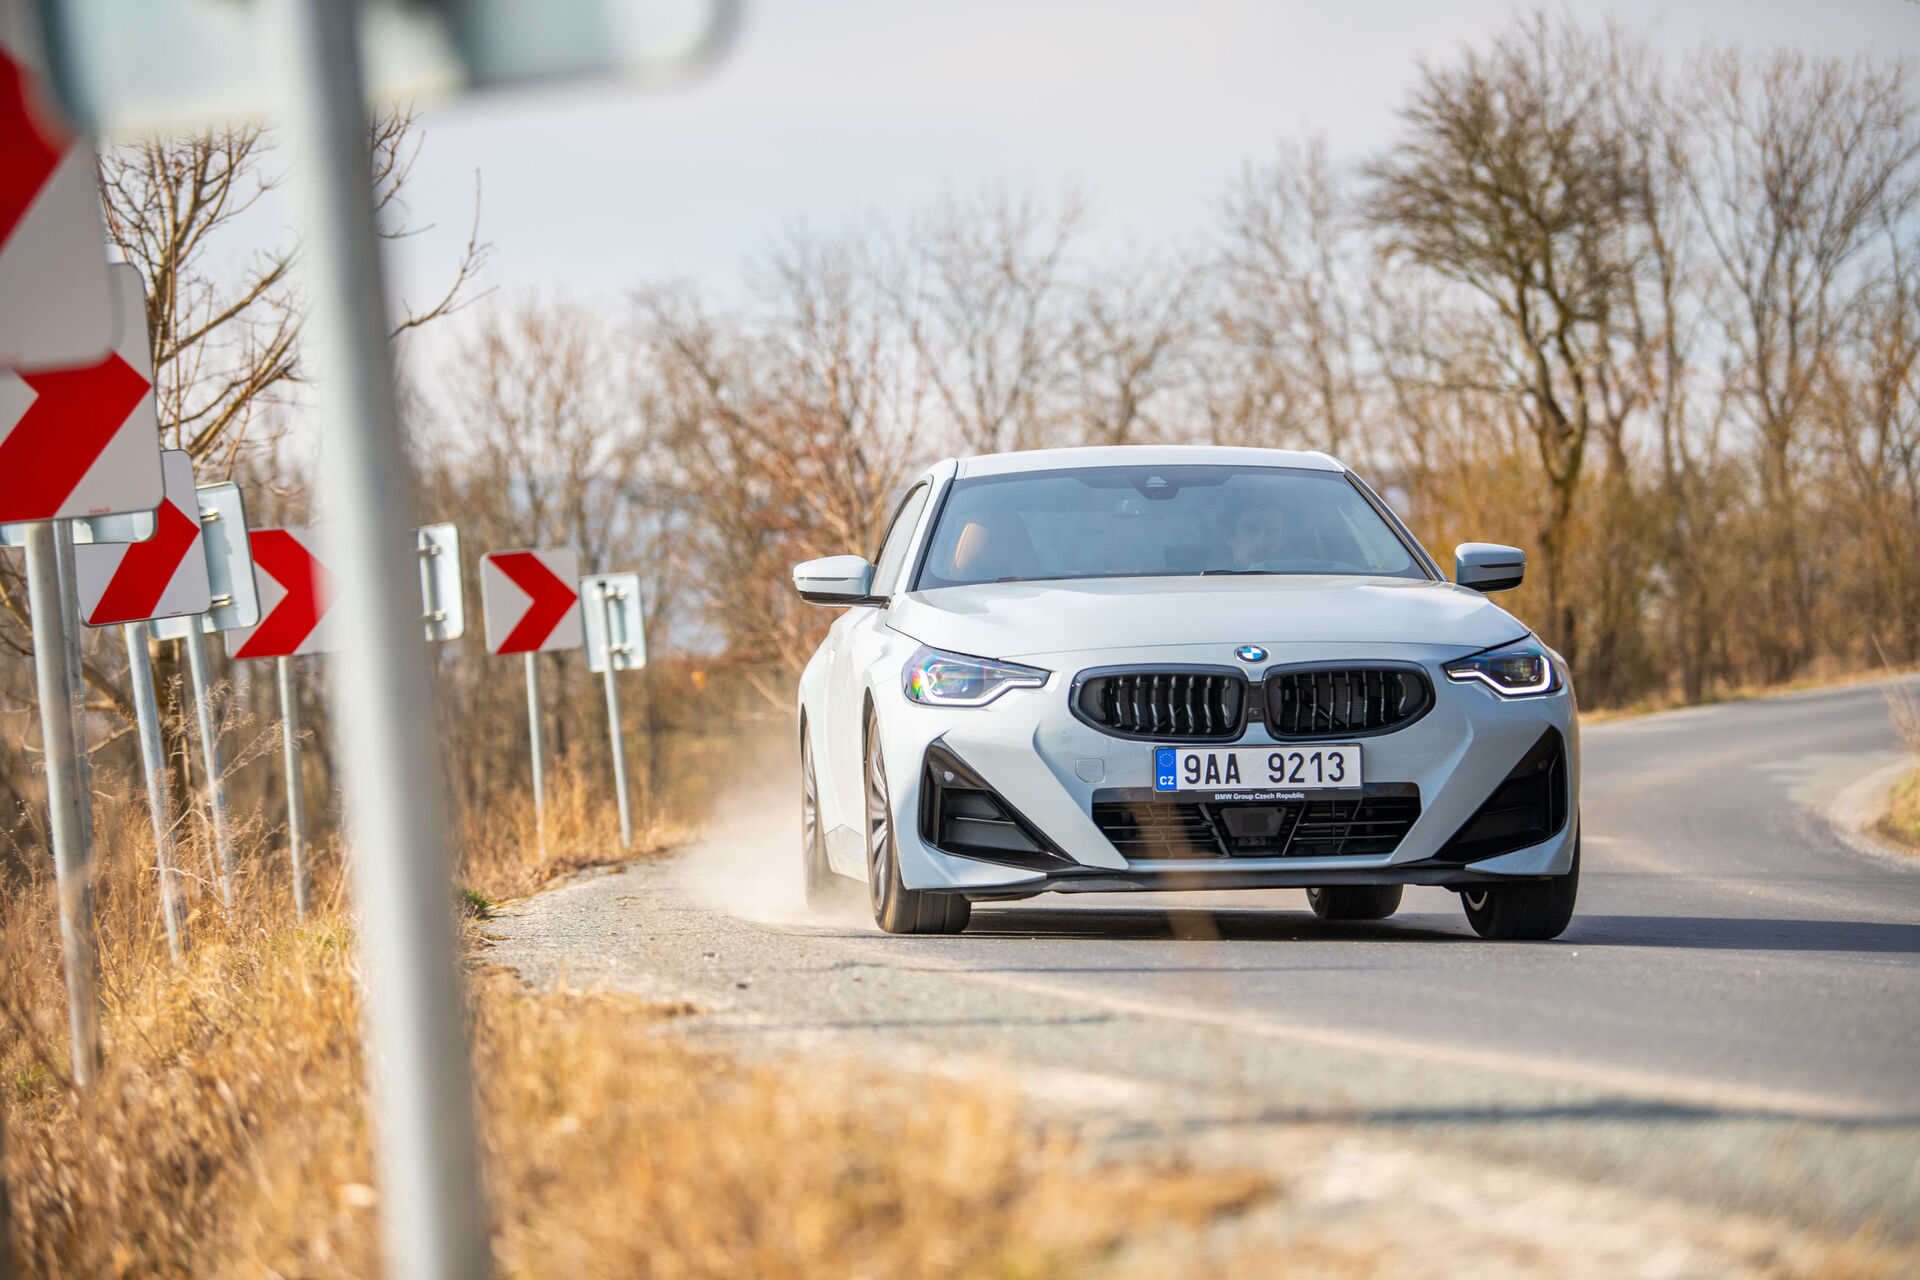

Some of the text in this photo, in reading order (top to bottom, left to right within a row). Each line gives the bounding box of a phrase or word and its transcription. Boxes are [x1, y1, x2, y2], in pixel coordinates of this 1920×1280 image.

[1184, 752, 1345, 785] 9AA 9213
[1159, 776, 1174, 785] CZ
[1233, 793, 1253, 801] Group
[1276, 792, 1305, 800] Republic
